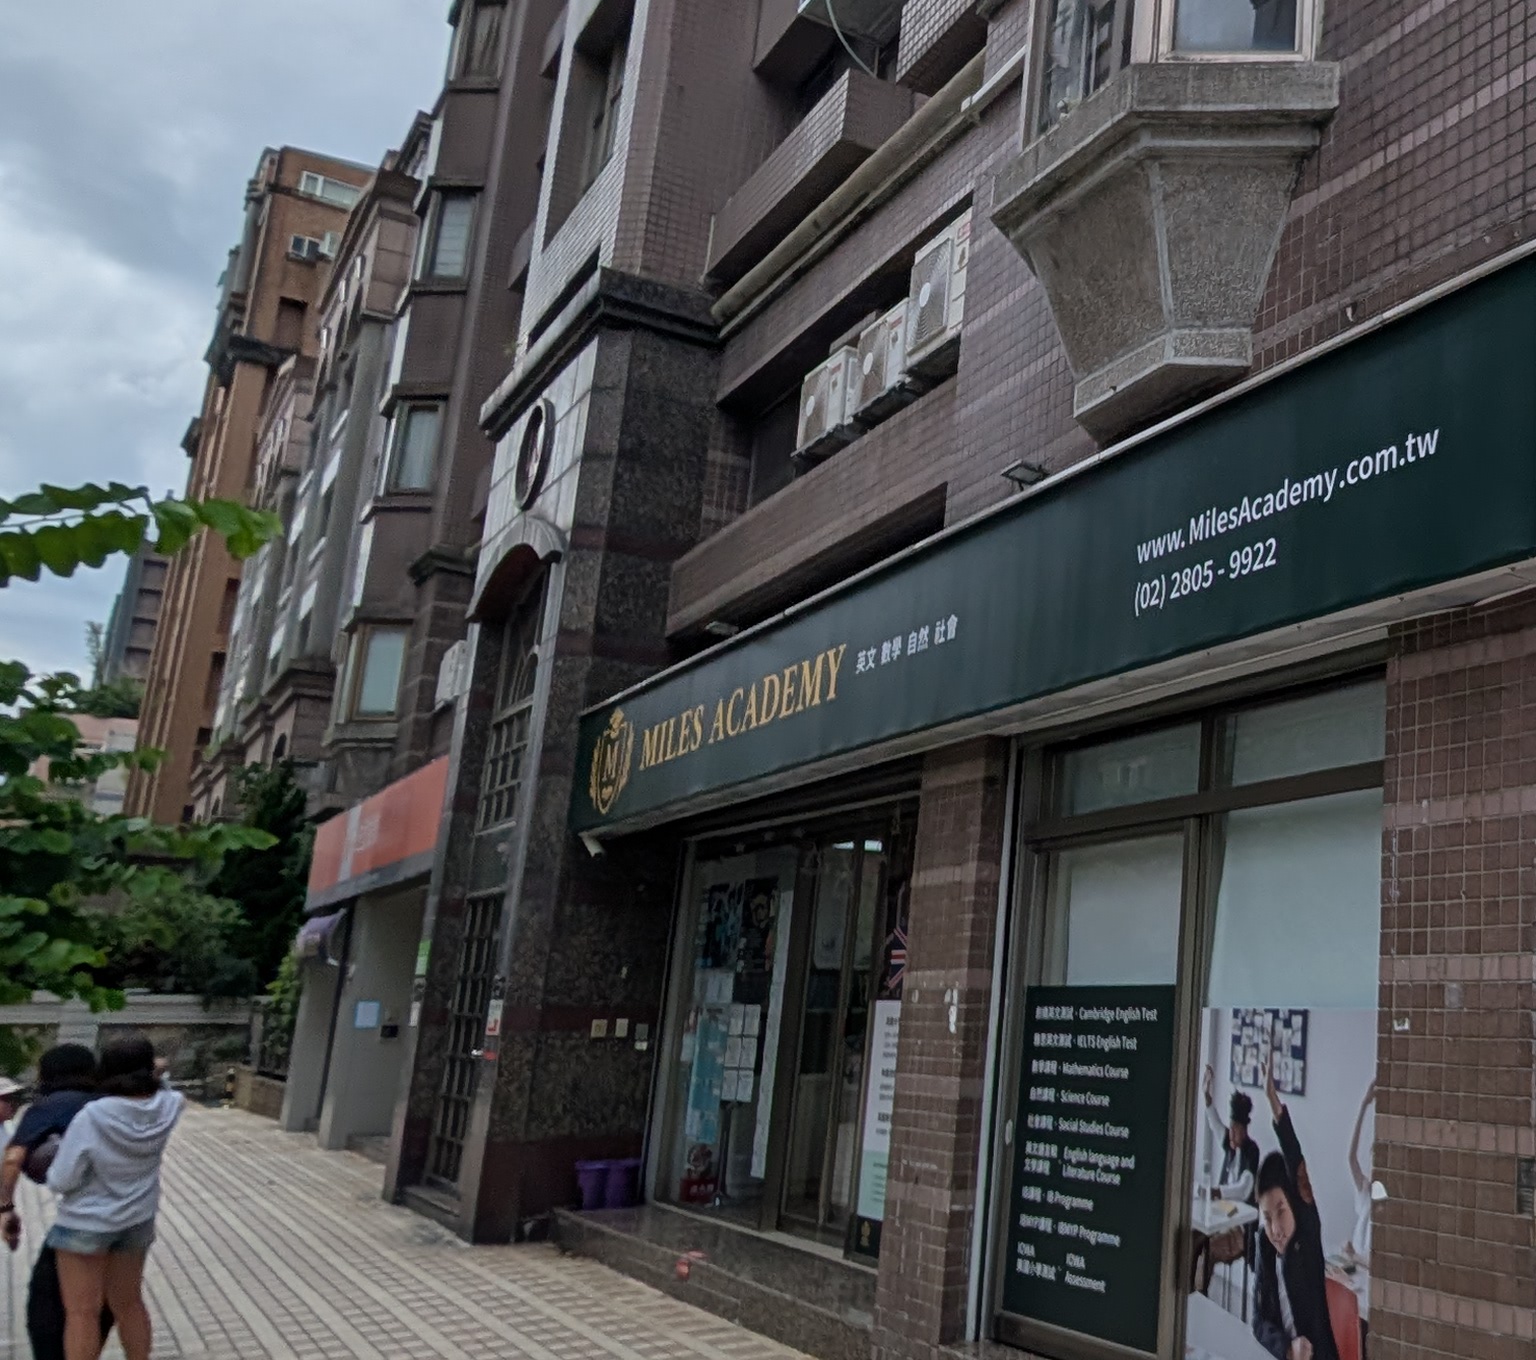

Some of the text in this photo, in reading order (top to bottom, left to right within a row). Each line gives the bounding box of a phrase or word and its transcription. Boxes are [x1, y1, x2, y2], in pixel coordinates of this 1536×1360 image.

[1135, 574, 1166, 617] (02)
[1170, 560, 1214, 600] 2805
[1229, 538, 1277, 580] 9922
[855, 614, 958, 674] 英文 數學 自然 社會
[639, 644, 847, 771] MILES ACADEMY
[1116, 1007, 1140, 1024] English
[1142, 1007, 1158, 1022] Test
[1096, 1034, 1121, 1052] English
[1122, 1035, 1138, 1051] Test
[1104, 1064, 1129, 1080] Course
[1060, 1089, 1110, 1107] Science Course
[1104, 1122, 1130, 1139] Course
